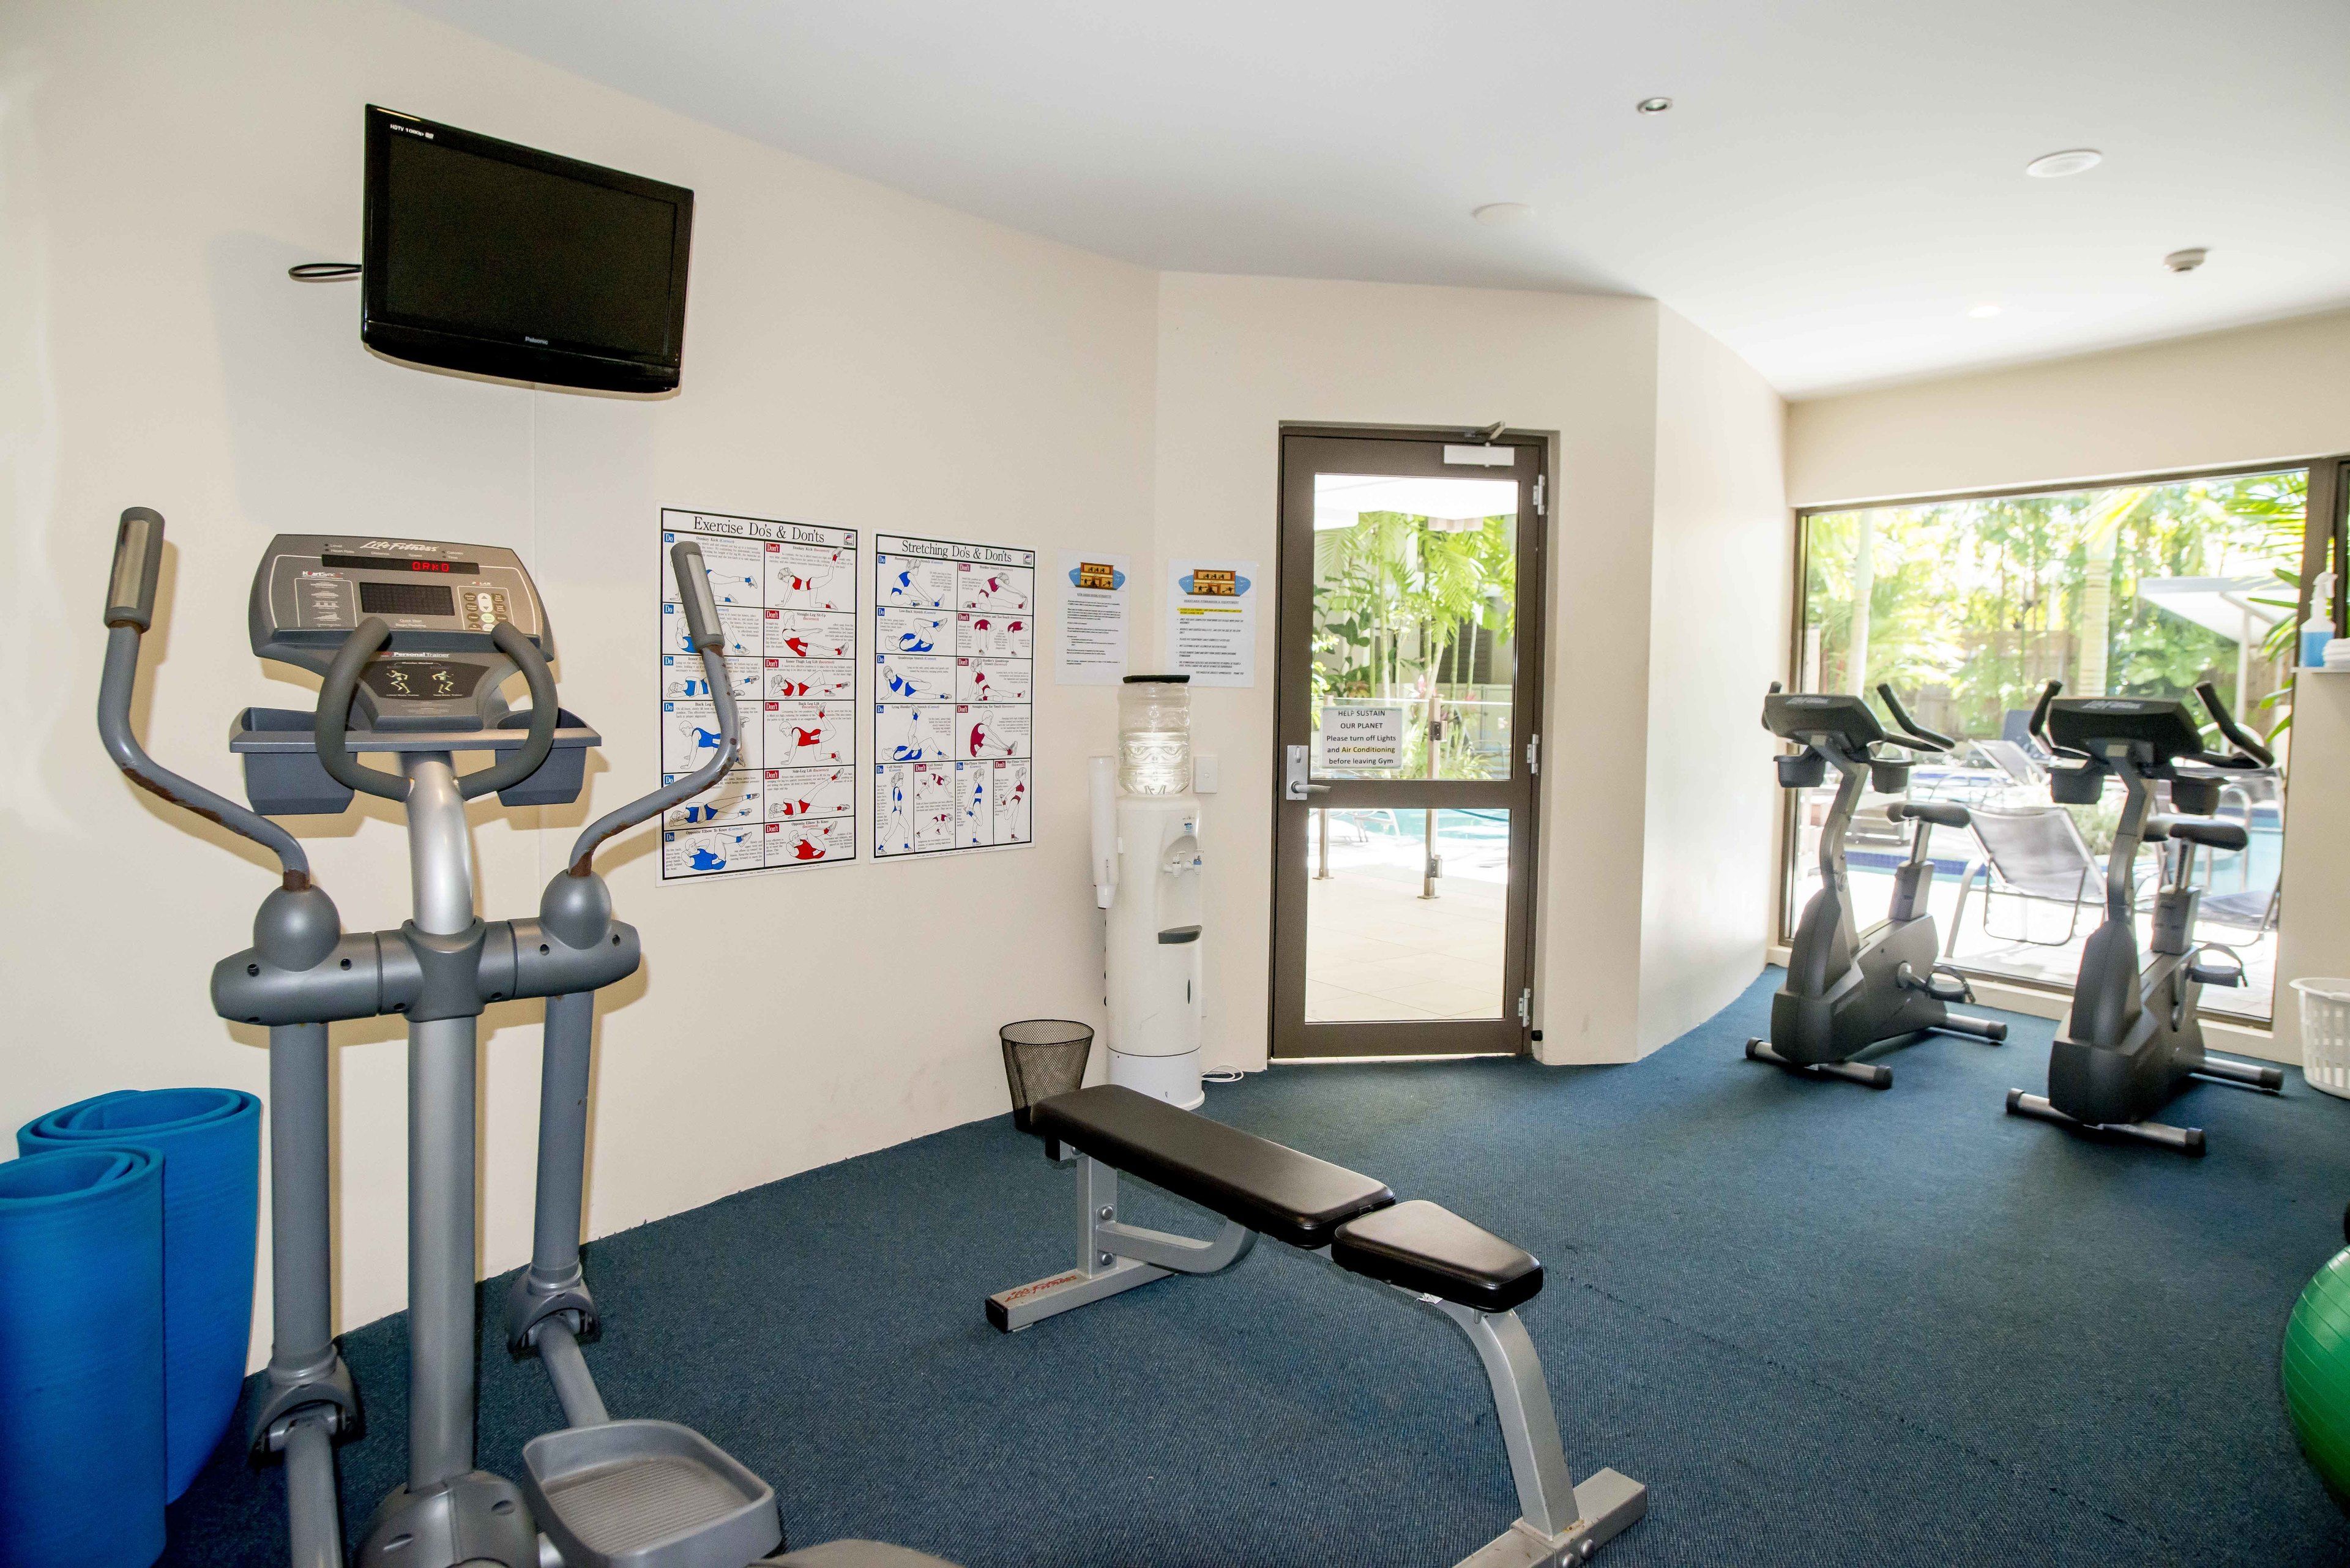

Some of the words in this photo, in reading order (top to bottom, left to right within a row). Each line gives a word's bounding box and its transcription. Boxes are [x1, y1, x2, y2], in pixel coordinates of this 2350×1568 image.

[694, 516, 743, 534] Exercise
[749, 522, 772, 537] Do's
[777, 525, 786, 539] &
[792, 527, 824, 542] Don'ts
[360, 540, 390, 550] Life
[389, 542, 439, 551] Fitness
[902, 540, 948, 558] Stretching
[952, 545, 970, 558] Do's
[973, 548, 980, 559] &
[985, 549, 1012, 562] Don'ts
